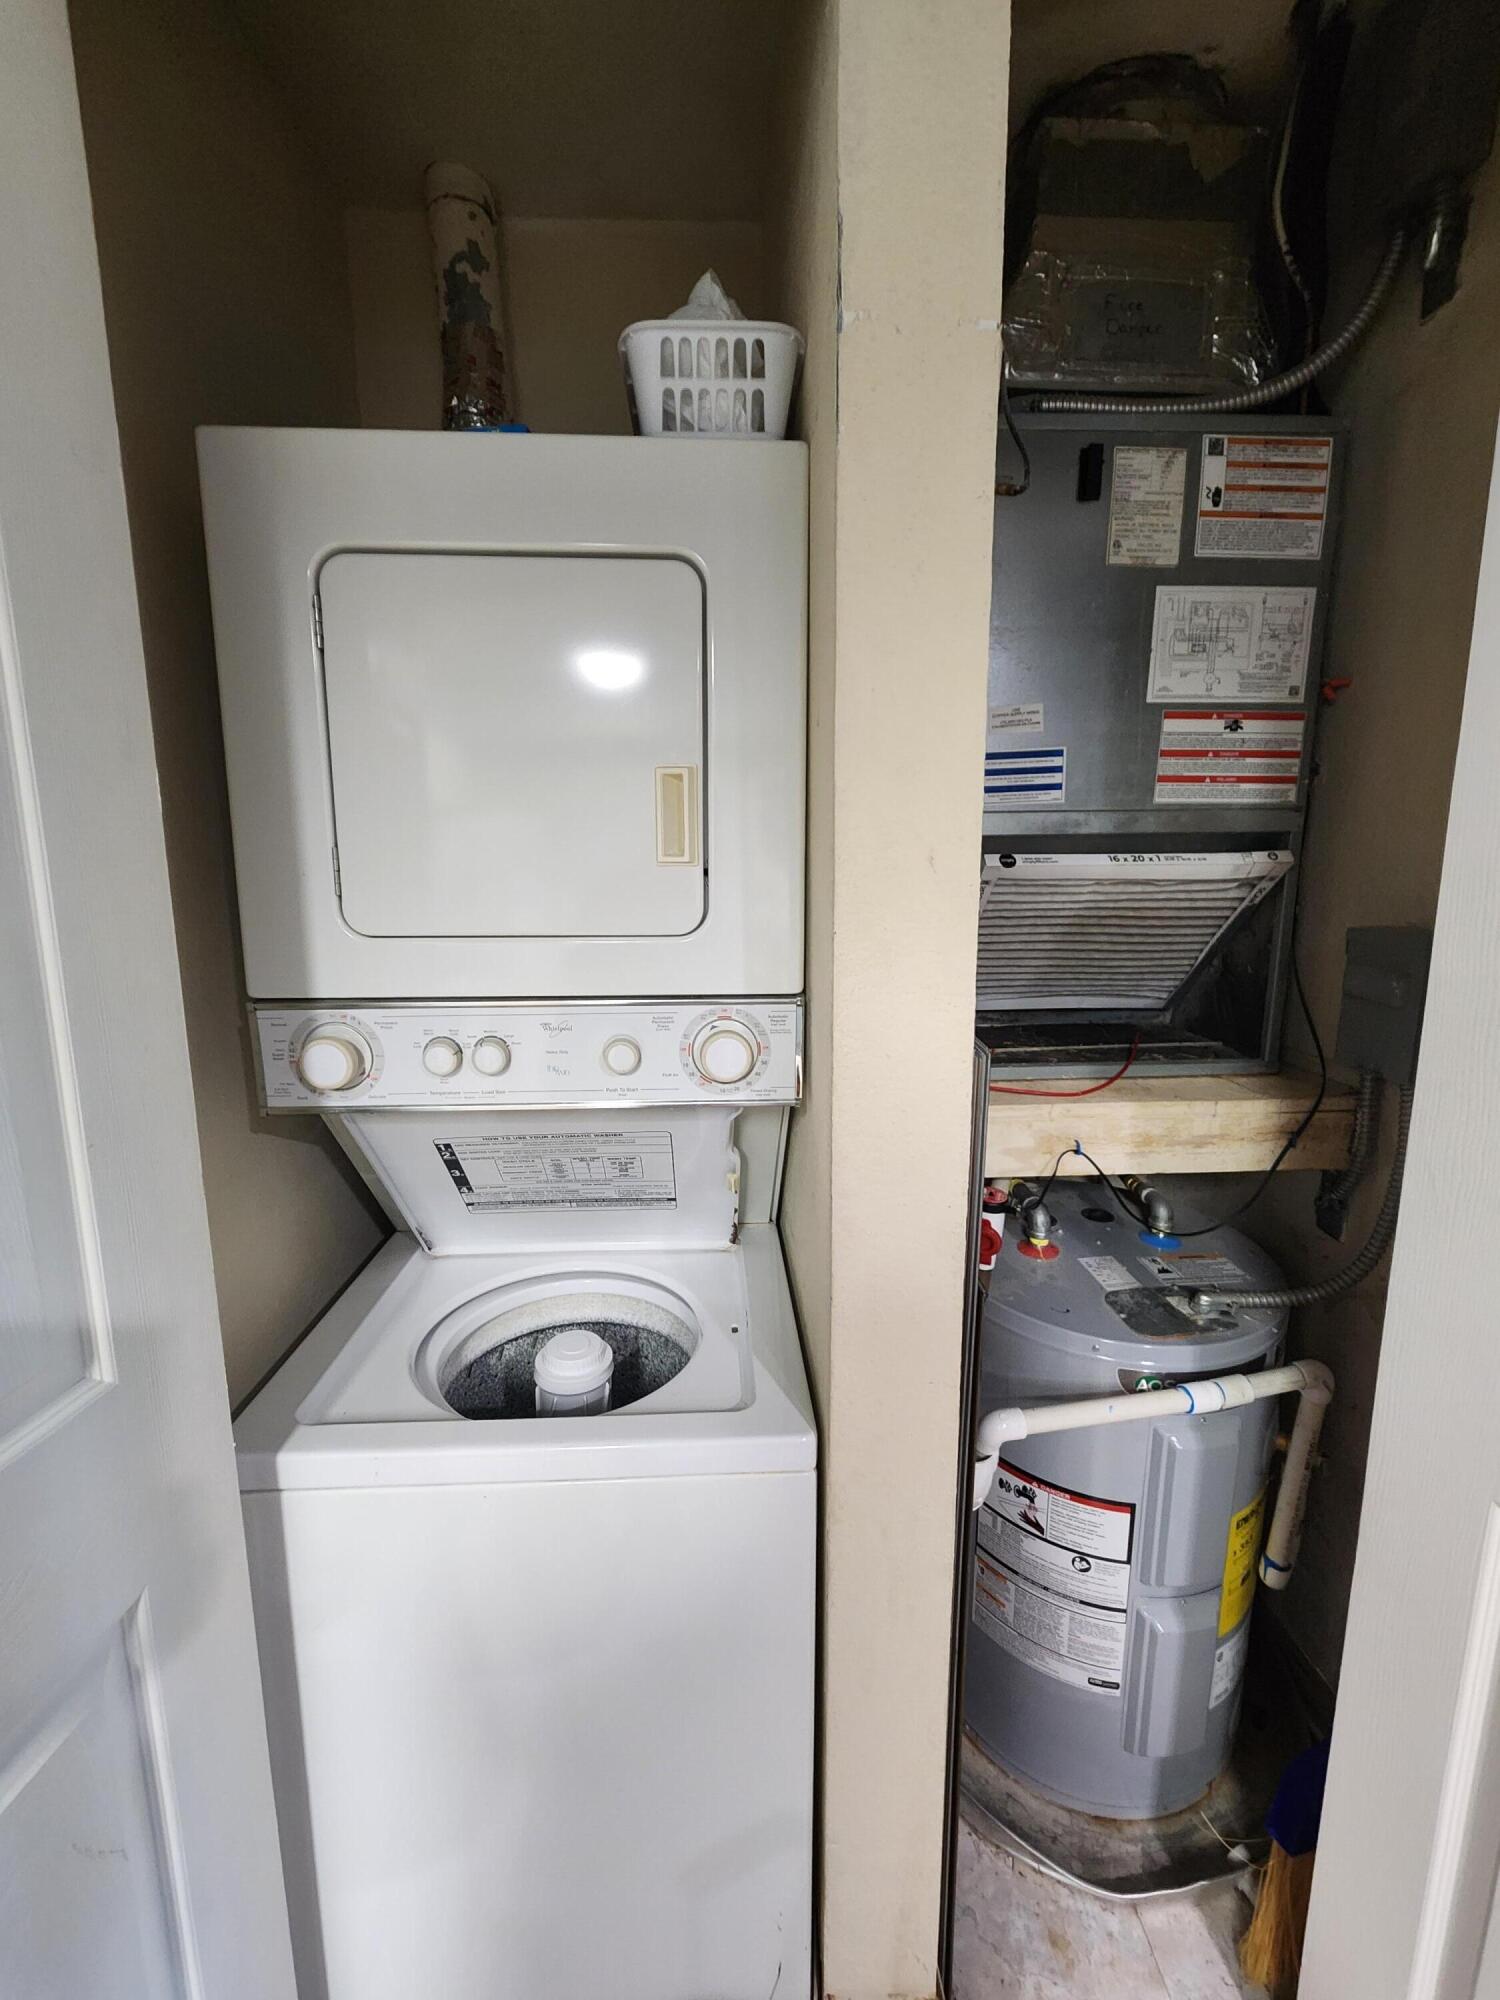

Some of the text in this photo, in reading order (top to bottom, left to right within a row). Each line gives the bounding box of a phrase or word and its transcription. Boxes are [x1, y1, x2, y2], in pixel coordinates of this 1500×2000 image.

[1107, 854, 1120, 862] 16
[1131, 854, 1145, 862] 20
[1155, 854, 1161, 862] 1
[540, 1020, 573, 1035] Whirlpool
[1039, 1485, 1071, 1500] DANGER
